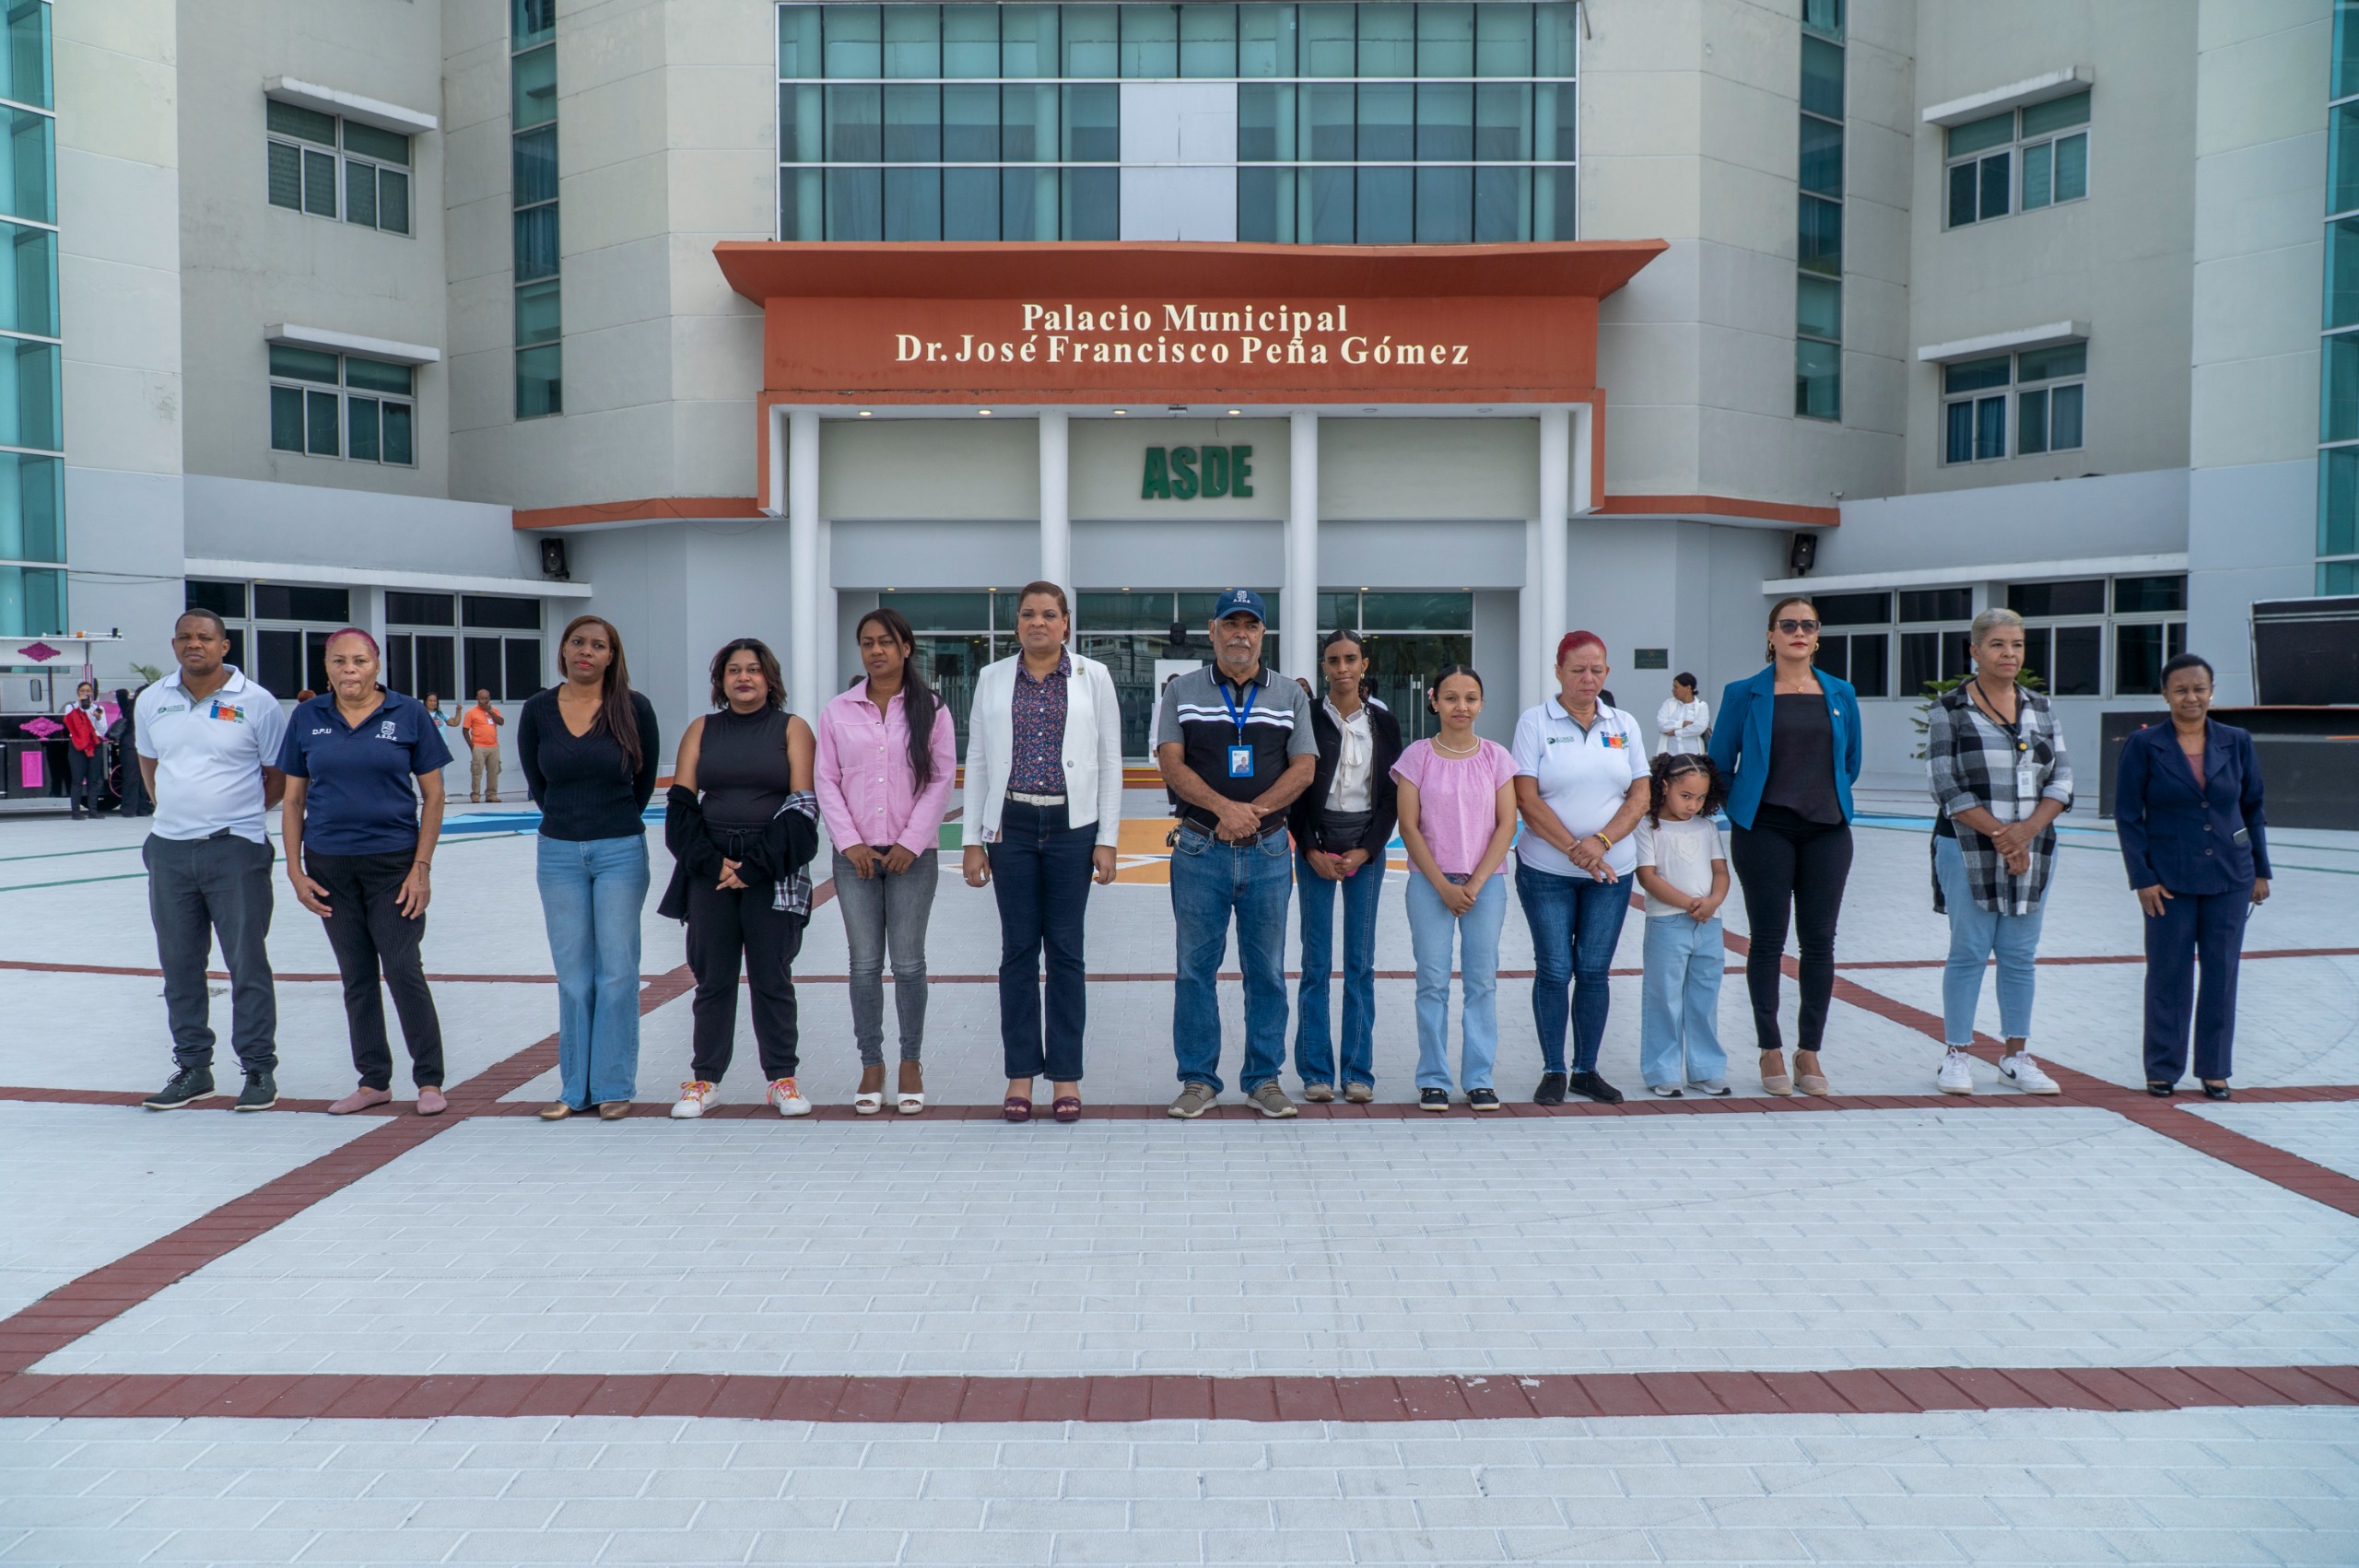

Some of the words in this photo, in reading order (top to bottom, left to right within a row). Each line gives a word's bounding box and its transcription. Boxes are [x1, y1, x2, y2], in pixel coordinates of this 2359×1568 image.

[1022, 304, 1152, 332] Palacio
[1163, 304, 1347, 340] Municipal
[895, 334, 948, 362] Dr.
[955, 334, 1039, 363] José
[1047, 335, 1229, 364] Francisco
[1240, 336, 1328, 365] Peña
[1341, 335, 1469, 365] Gómez
[1141, 445, 1253, 500] ASDE
